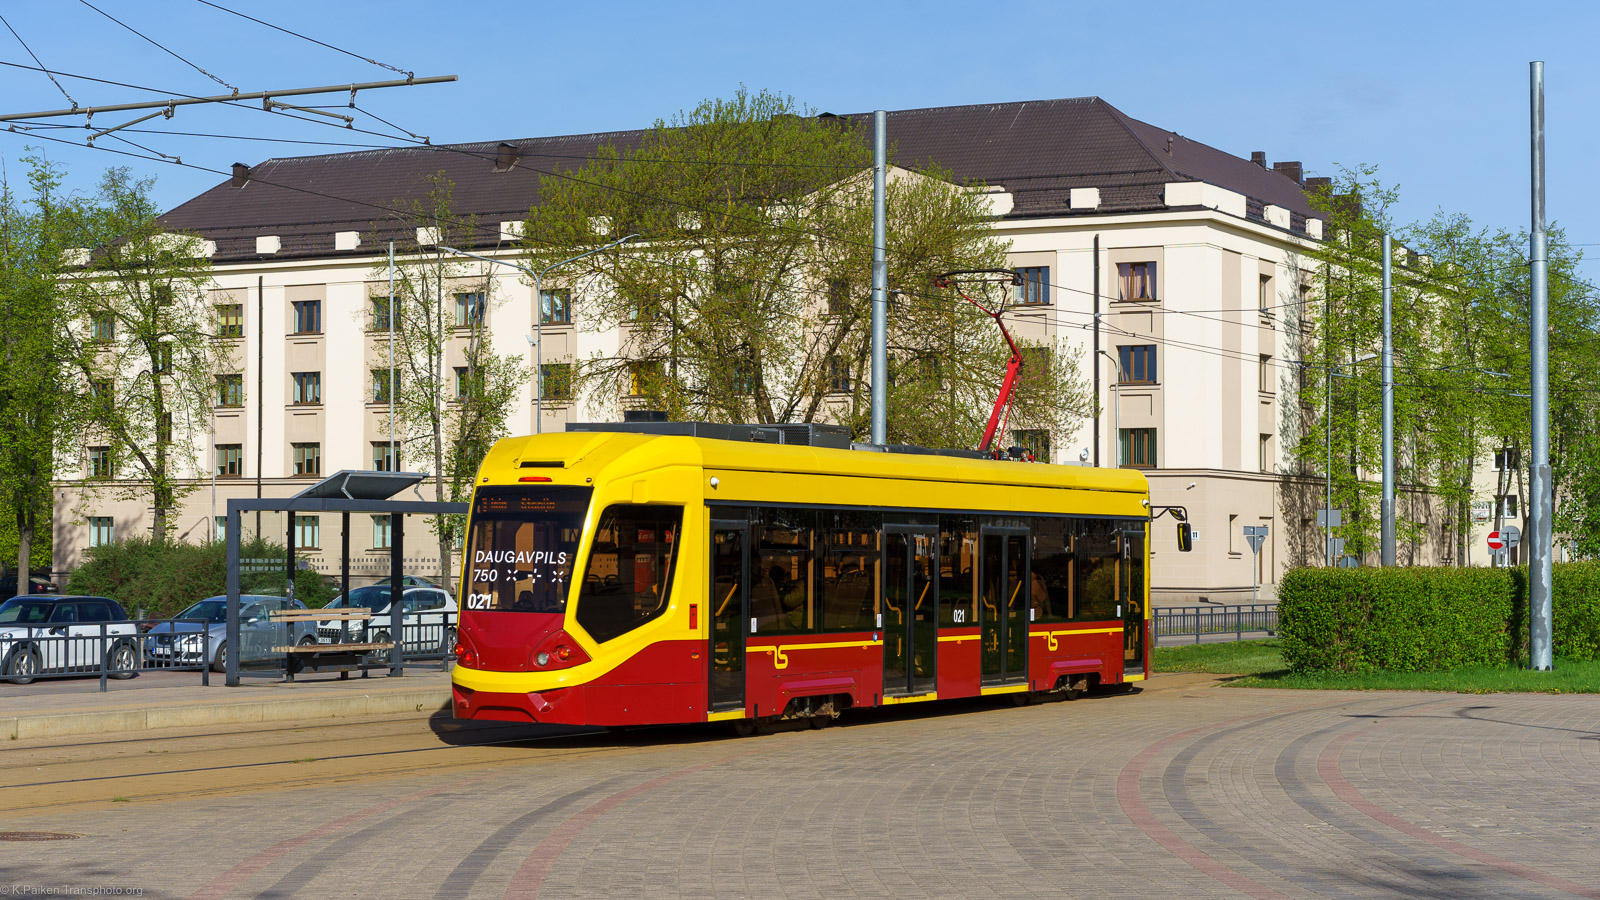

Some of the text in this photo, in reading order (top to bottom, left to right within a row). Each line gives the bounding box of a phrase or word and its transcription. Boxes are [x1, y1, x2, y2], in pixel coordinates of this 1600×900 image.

[475, 550, 567, 565] DAUGAVPILS
[473, 569, 498, 582] 750
[467, 593, 492, 609] 021
[953, 609, 965, 623] 021
